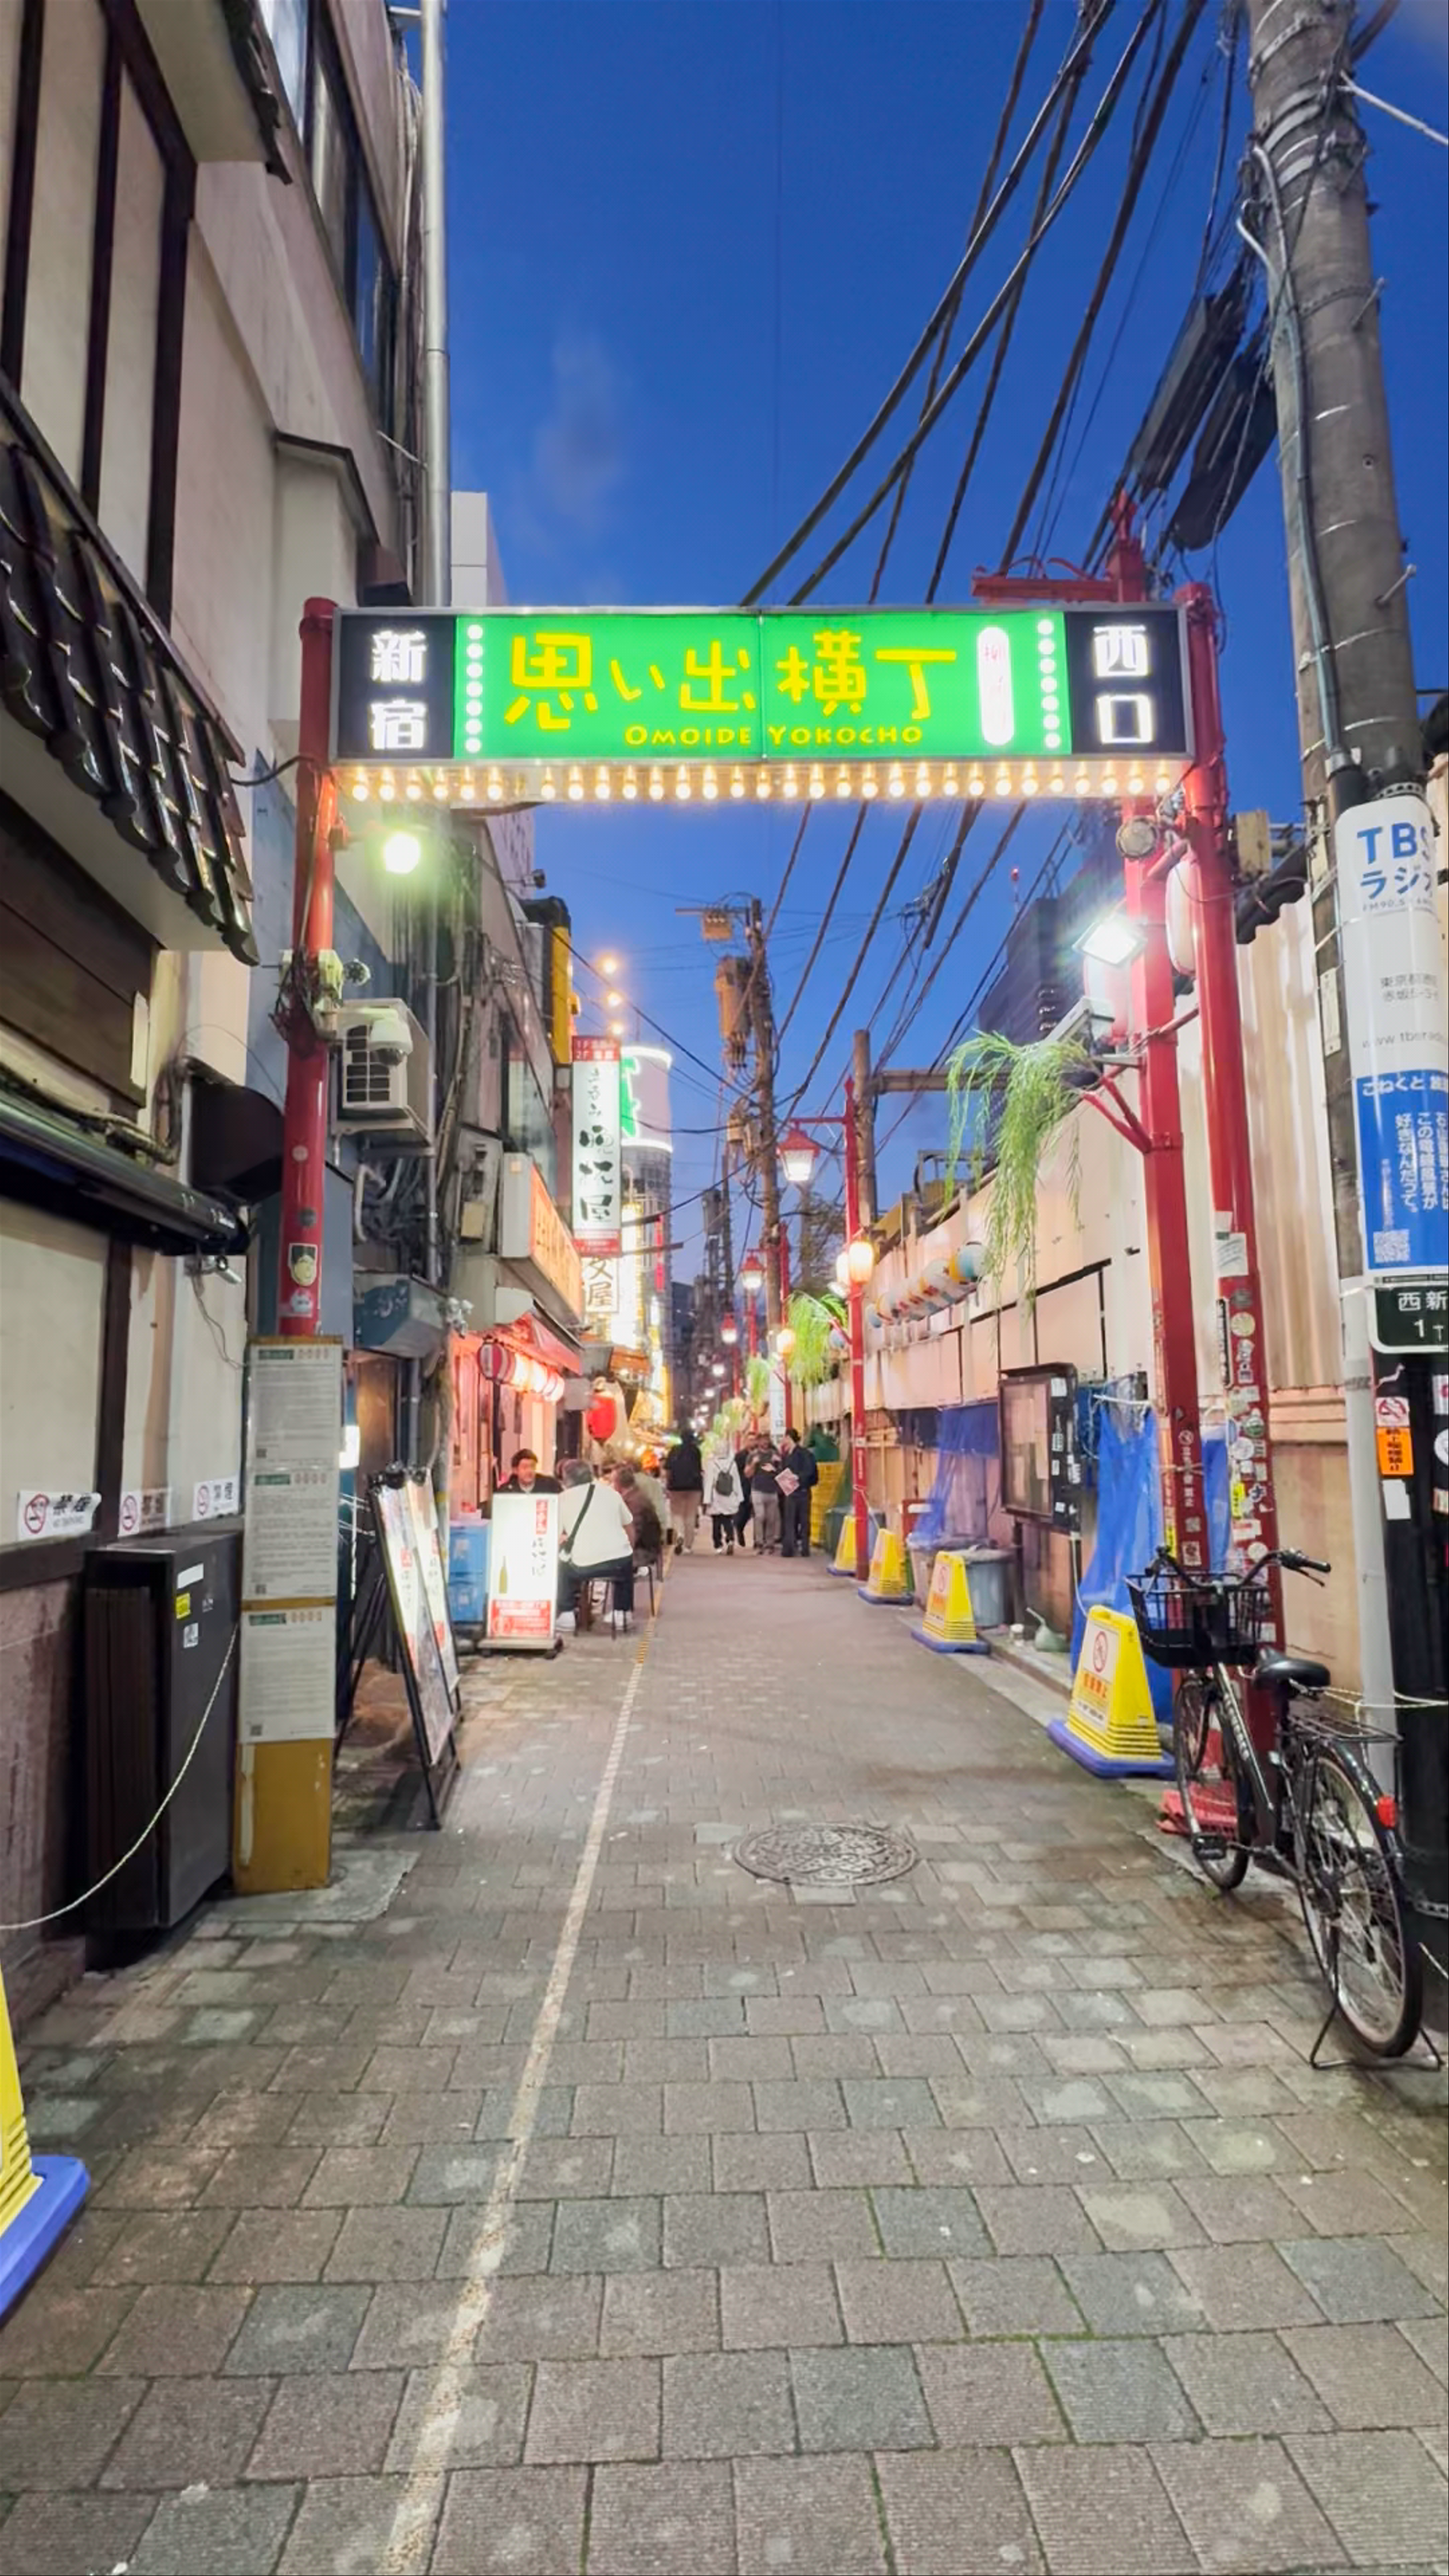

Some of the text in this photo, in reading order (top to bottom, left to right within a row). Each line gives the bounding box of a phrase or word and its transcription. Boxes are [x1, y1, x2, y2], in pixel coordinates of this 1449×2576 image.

[371, 629, 428, 750] 新宿
[505, 630, 957, 731] 思い出横丁
[1093, 624, 1153, 744] 西口
[625, 726, 923, 746] OMOIDE YOKOCHO
